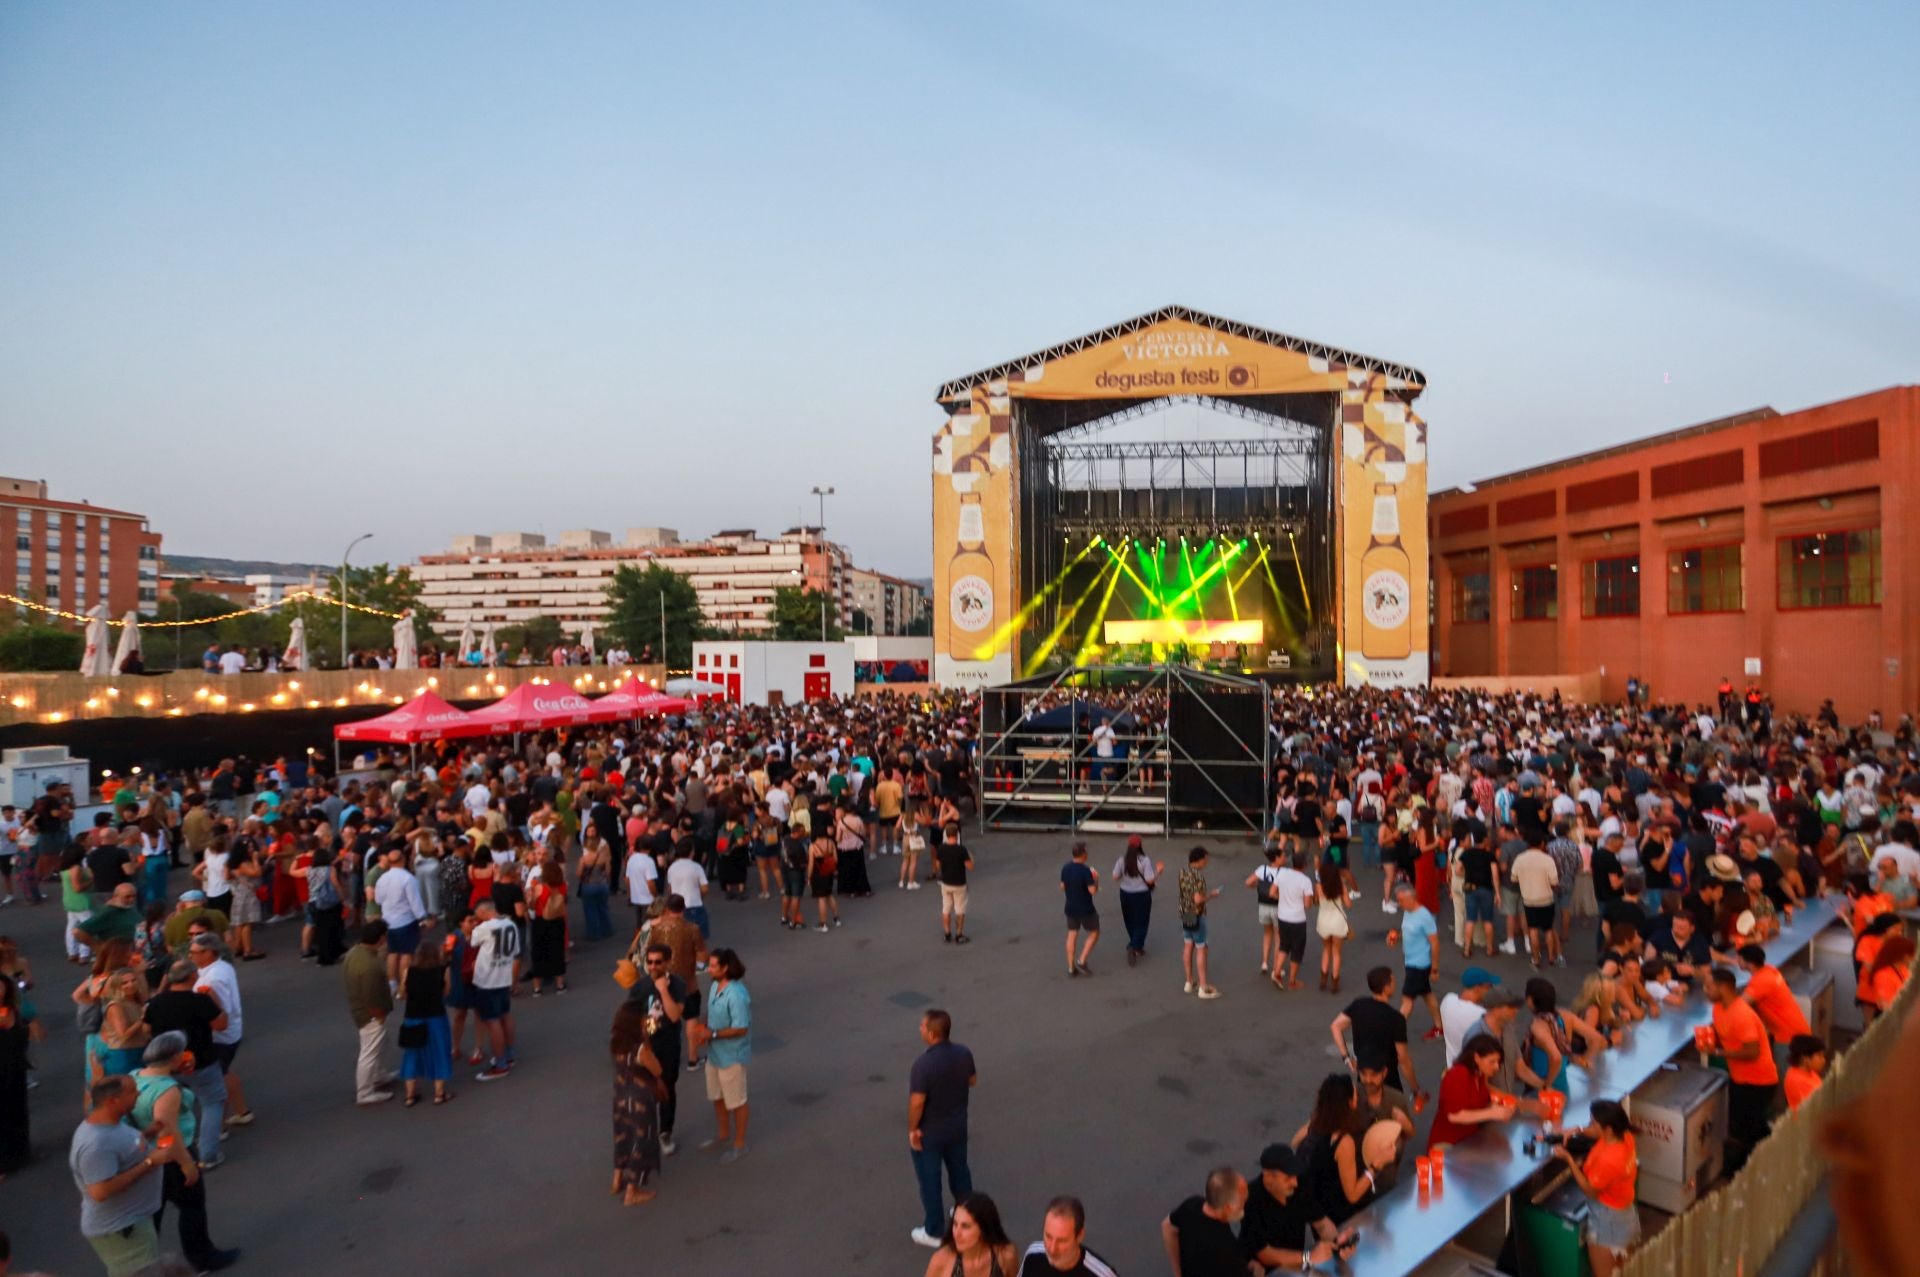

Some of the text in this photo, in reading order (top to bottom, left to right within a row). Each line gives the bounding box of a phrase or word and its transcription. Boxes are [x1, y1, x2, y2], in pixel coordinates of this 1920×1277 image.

[1122, 340, 1231, 361] VICTORIA
[1095, 367, 1220, 393] degusta fest
[491, 925, 516, 960] 10
